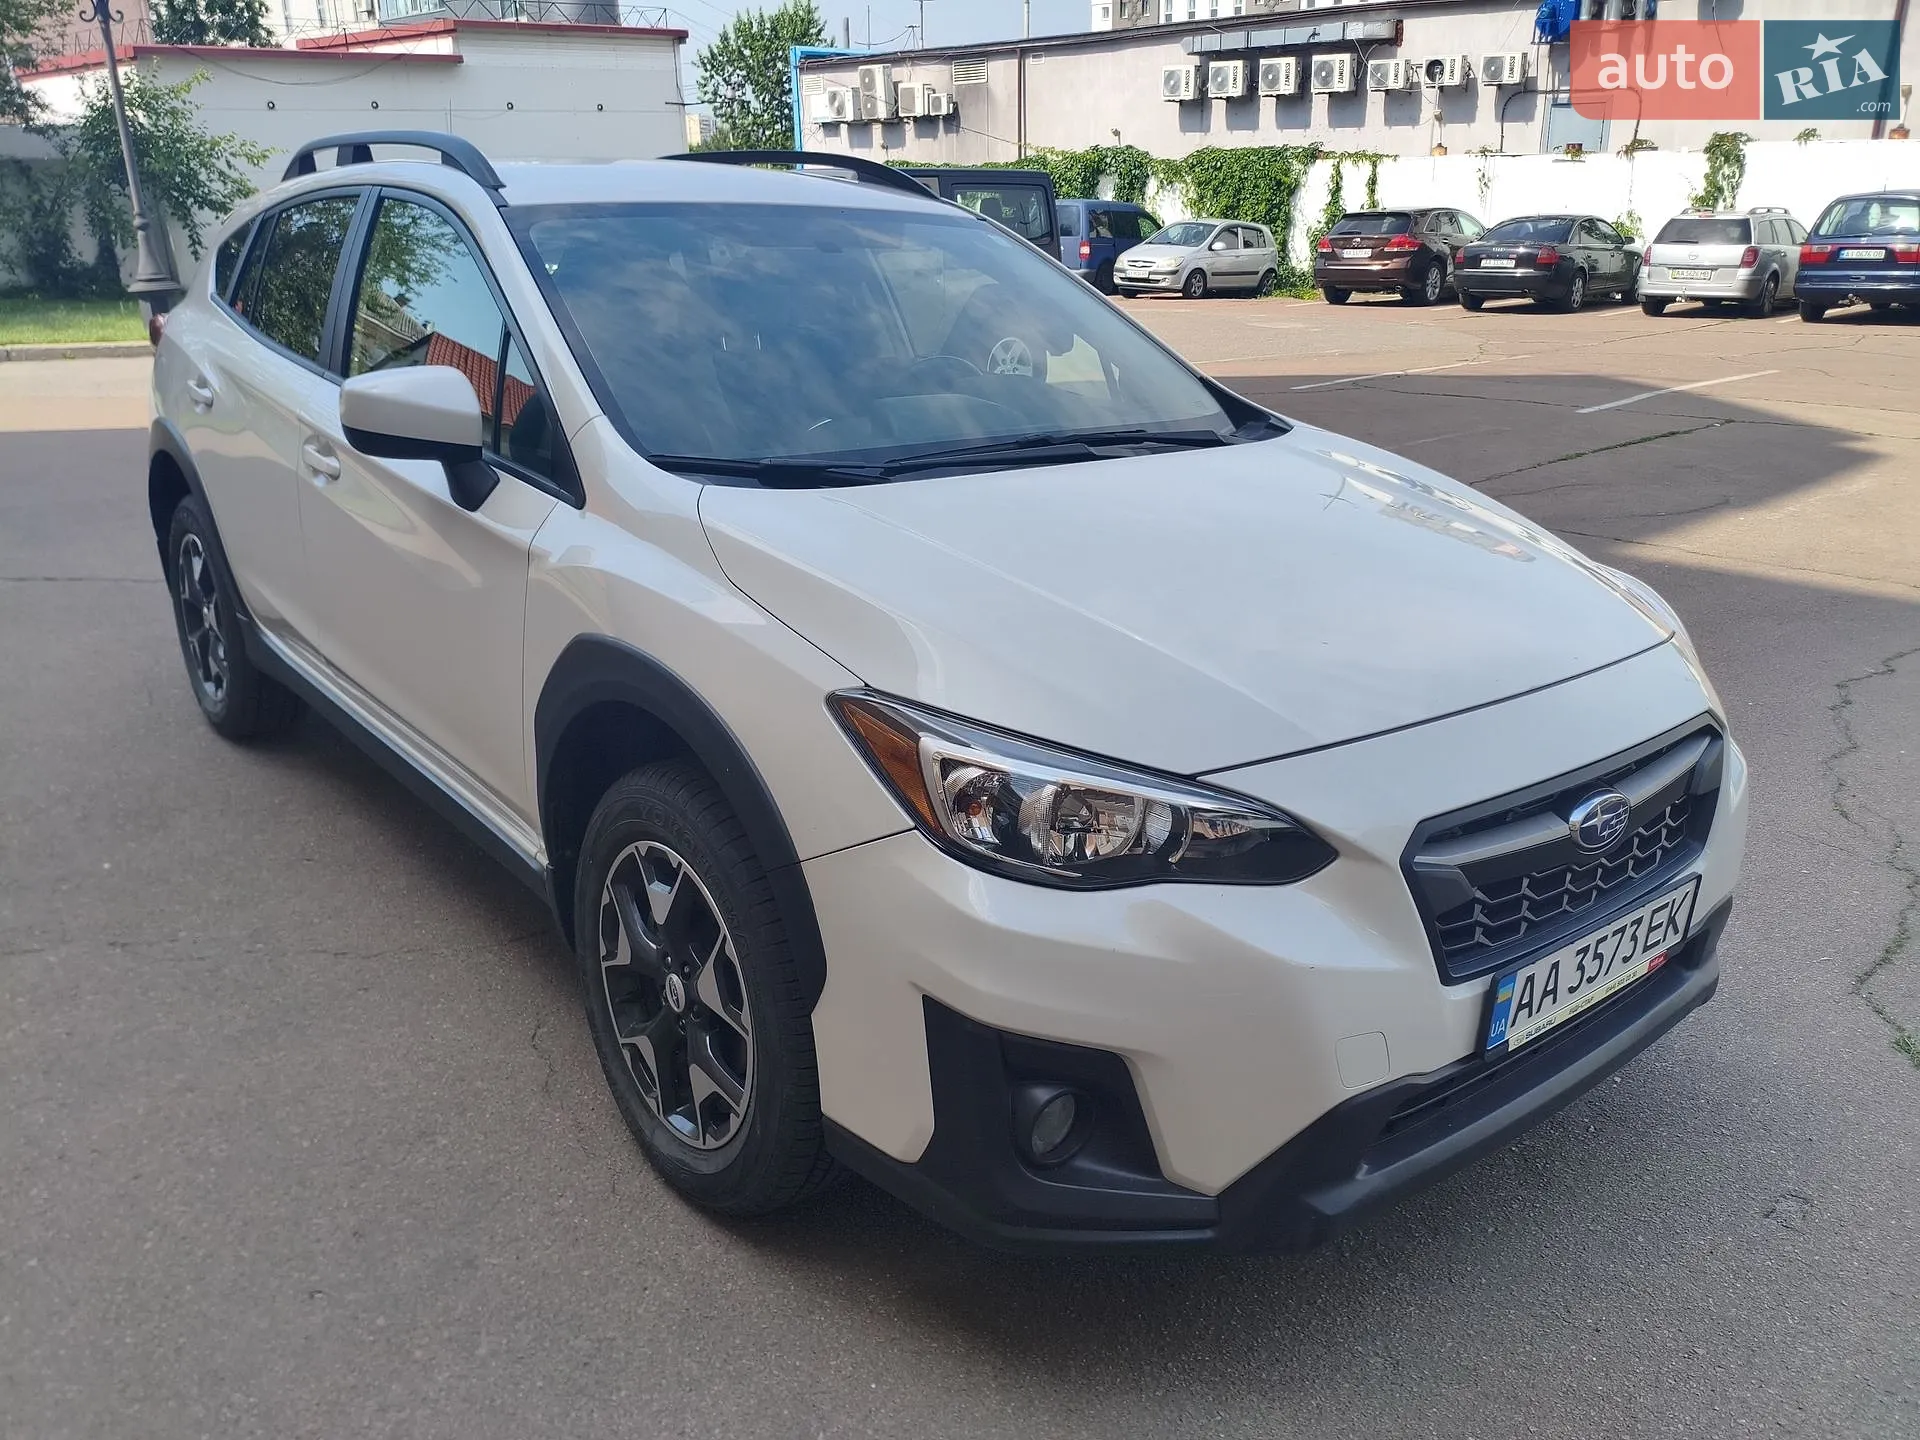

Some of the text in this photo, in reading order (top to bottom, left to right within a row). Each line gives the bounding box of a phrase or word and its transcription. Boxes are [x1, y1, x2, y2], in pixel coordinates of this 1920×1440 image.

[1510, 889, 1691, 1028] AA 3573 EK
[1490, 1017, 1505, 1037] UA
[1525, 1016, 1557, 1040] SUBARU
